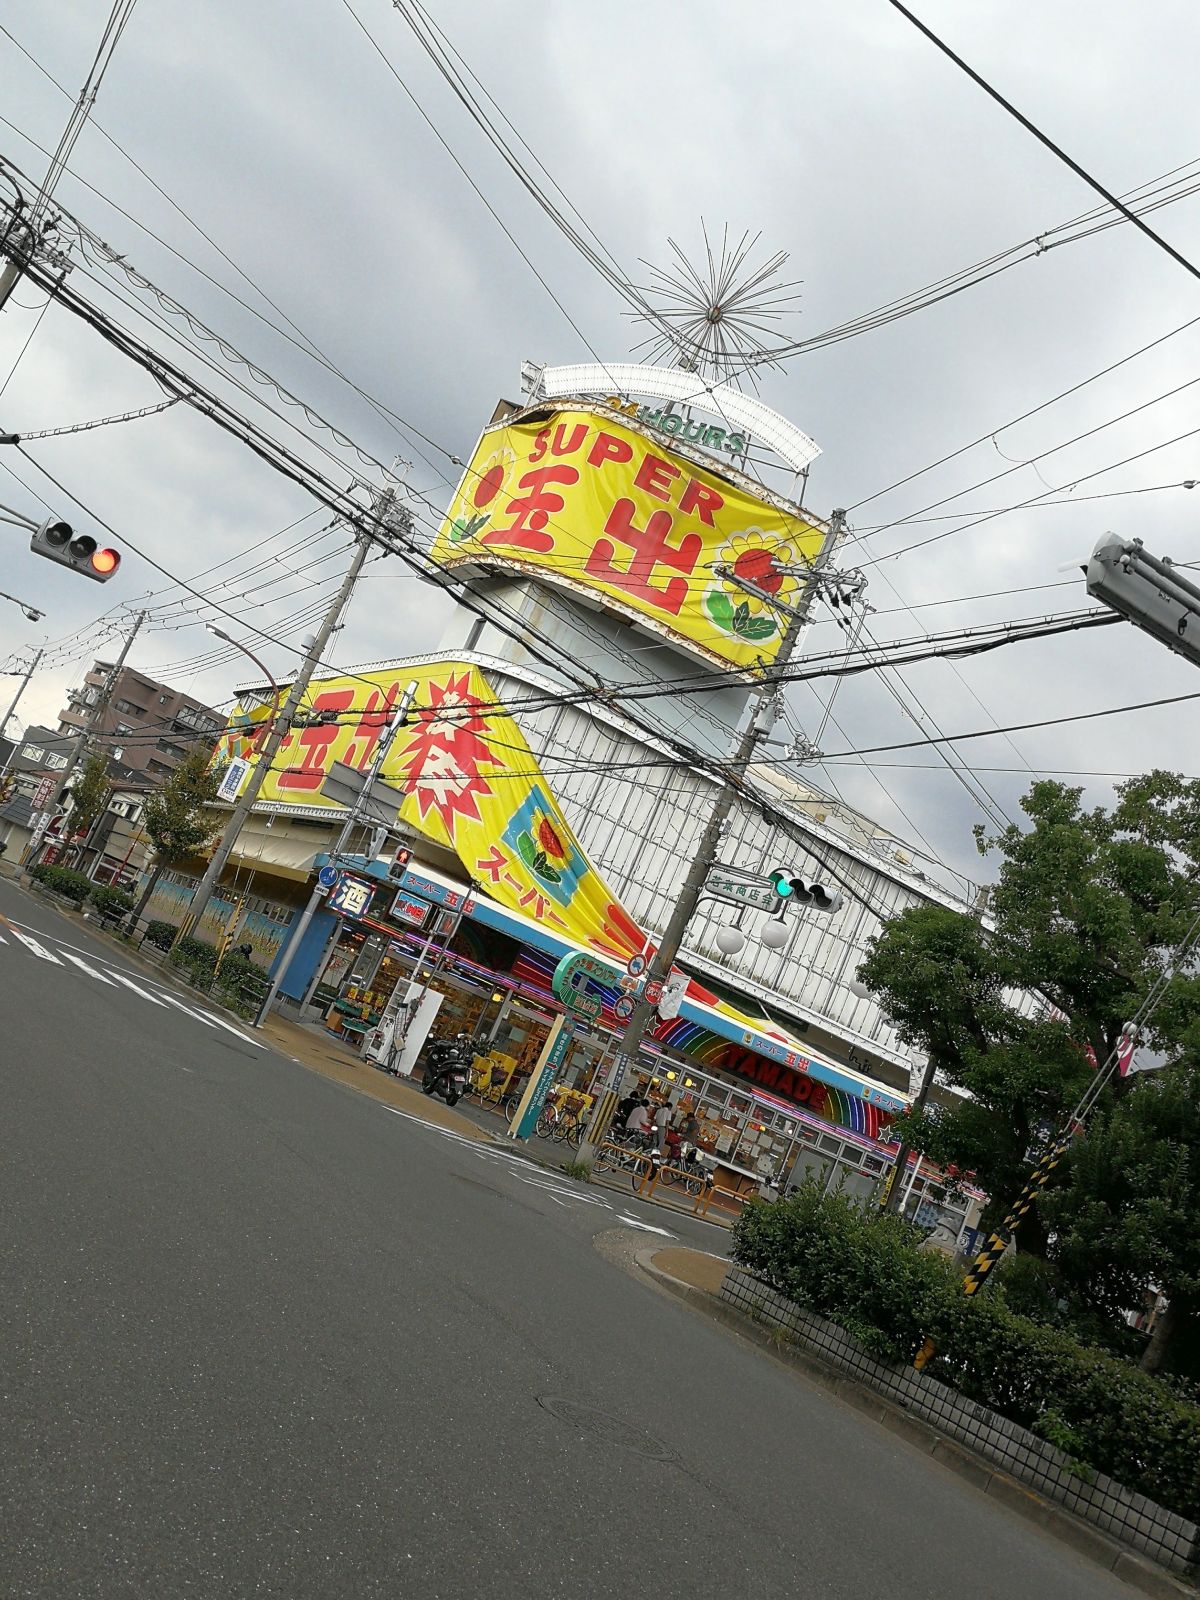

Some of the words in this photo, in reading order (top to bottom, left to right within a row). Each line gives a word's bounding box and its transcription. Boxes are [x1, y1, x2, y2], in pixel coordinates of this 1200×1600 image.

[638, 405, 747, 455] HOURS
[528, 424, 724, 528] SUPER
[479, 464, 703, 617] 玉出
[335, 879, 371, 915] 酒
[406, 875, 442, 896] スーパー
[476, 845, 569, 929] スーパー
[725, 1048, 829, 1109] TAMADE
[755, 1040, 782, 1057] スーパー
[783, 1053, 811, 1072] 玉出
